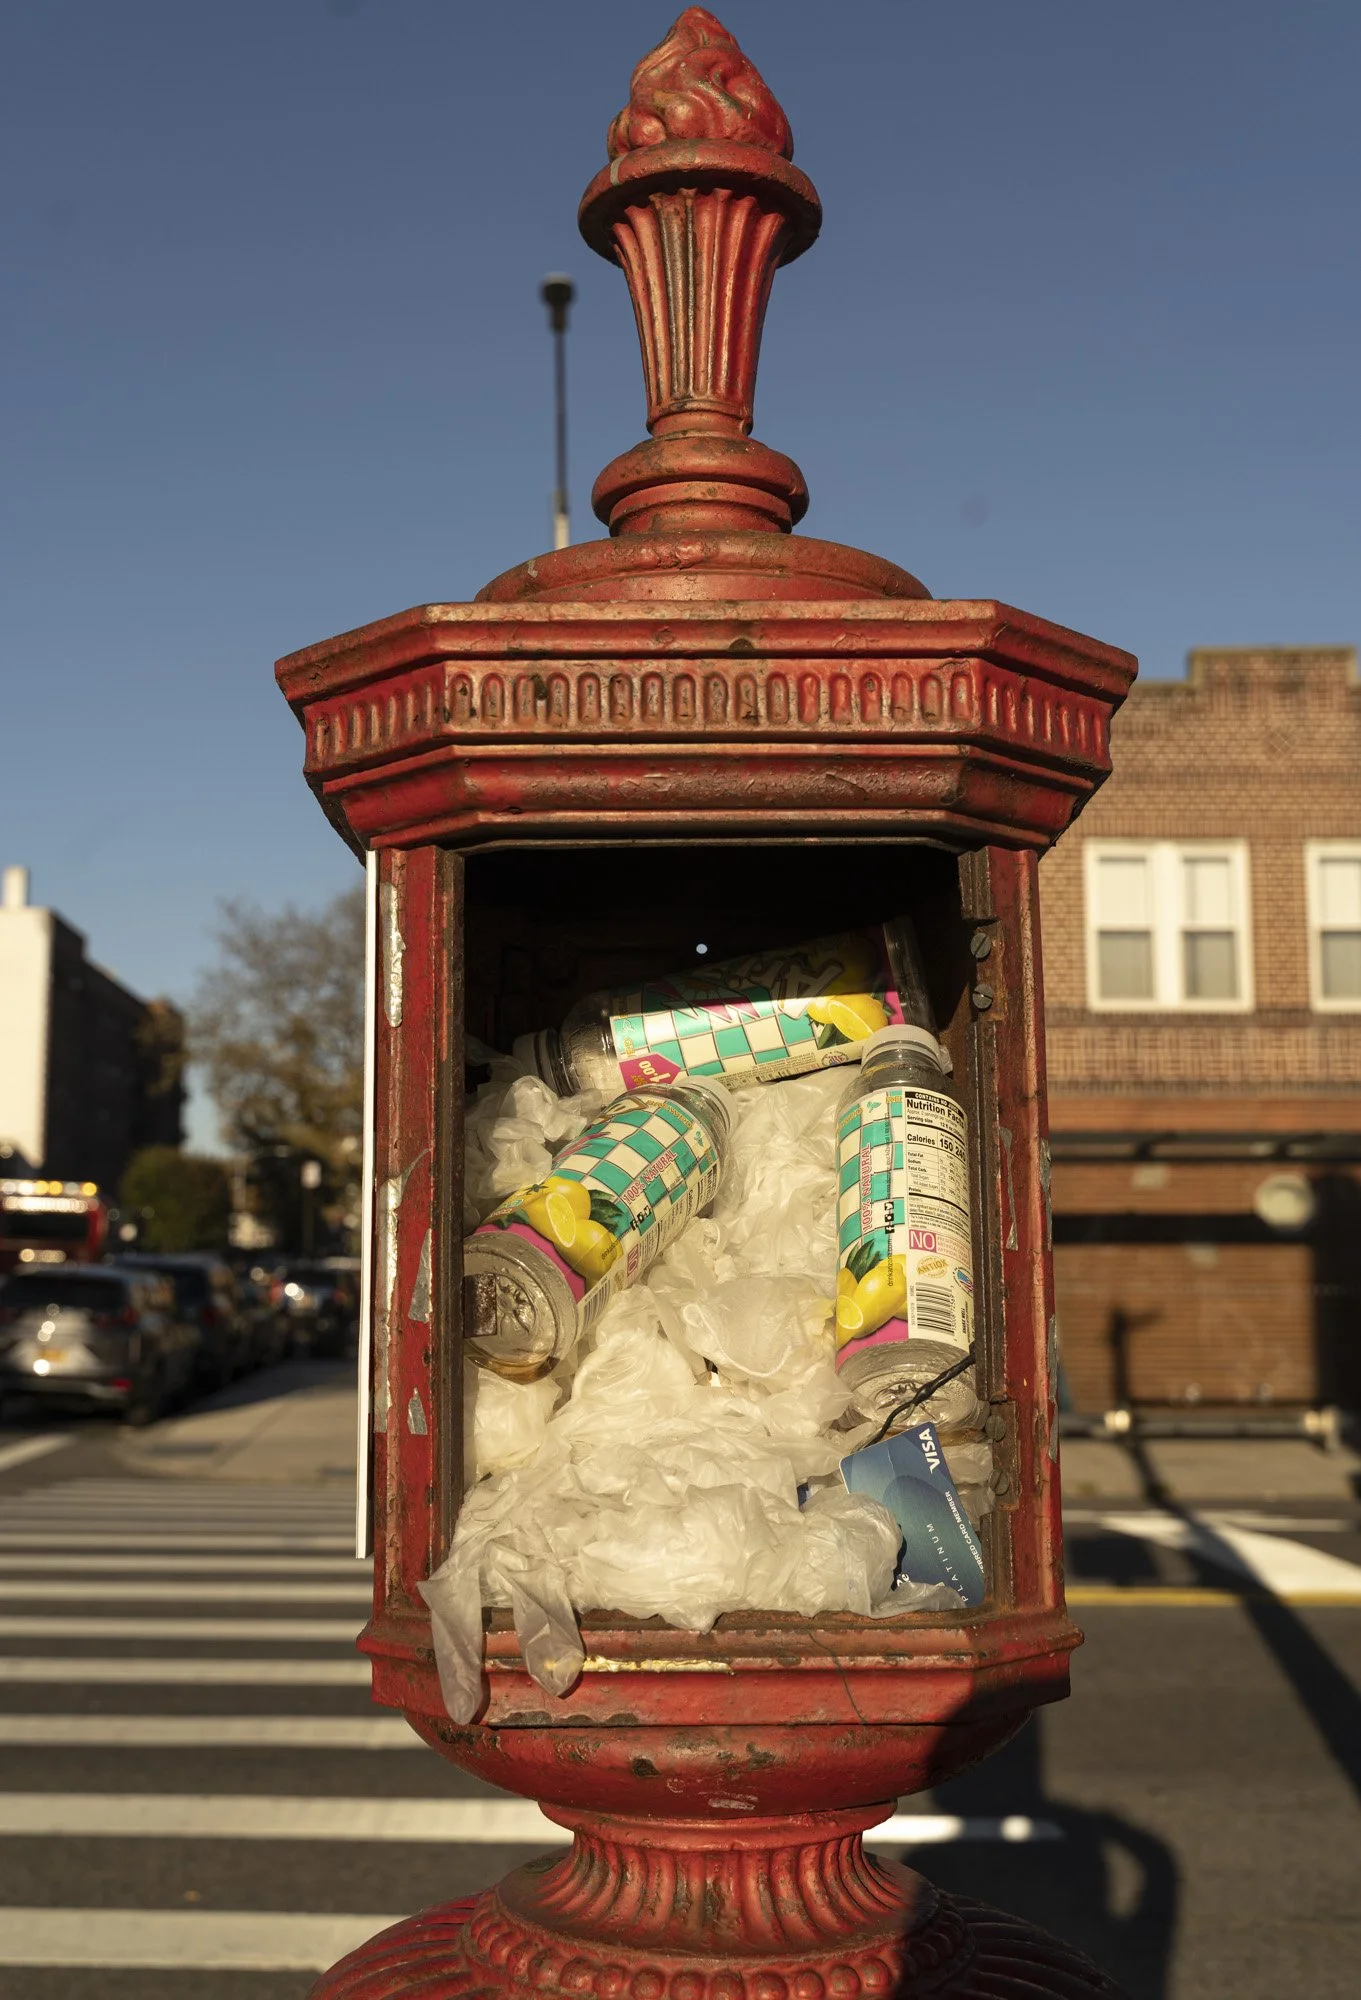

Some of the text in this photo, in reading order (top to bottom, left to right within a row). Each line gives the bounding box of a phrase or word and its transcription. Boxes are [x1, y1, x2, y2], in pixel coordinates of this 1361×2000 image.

[907, 1099, 946, 1115] Nutrition
[907, 1134, 936, 1145] Calories
[940, 1138, 954, 1152] 150
[621, 1180, 646, 1206] 100%
[642, 1150, 678, 1184] NATURAL
[861, 1143, 873, 1232] 100% NATURAL
[910, 1230, 936, 1250] NO
[918, 1428, 941, 1473] VISA
[944, 1491, 962, 1522] MEMBER
[958, 1522, 974, 1544] CARD
[926, 1522, 969, 1603] PLATINUM
